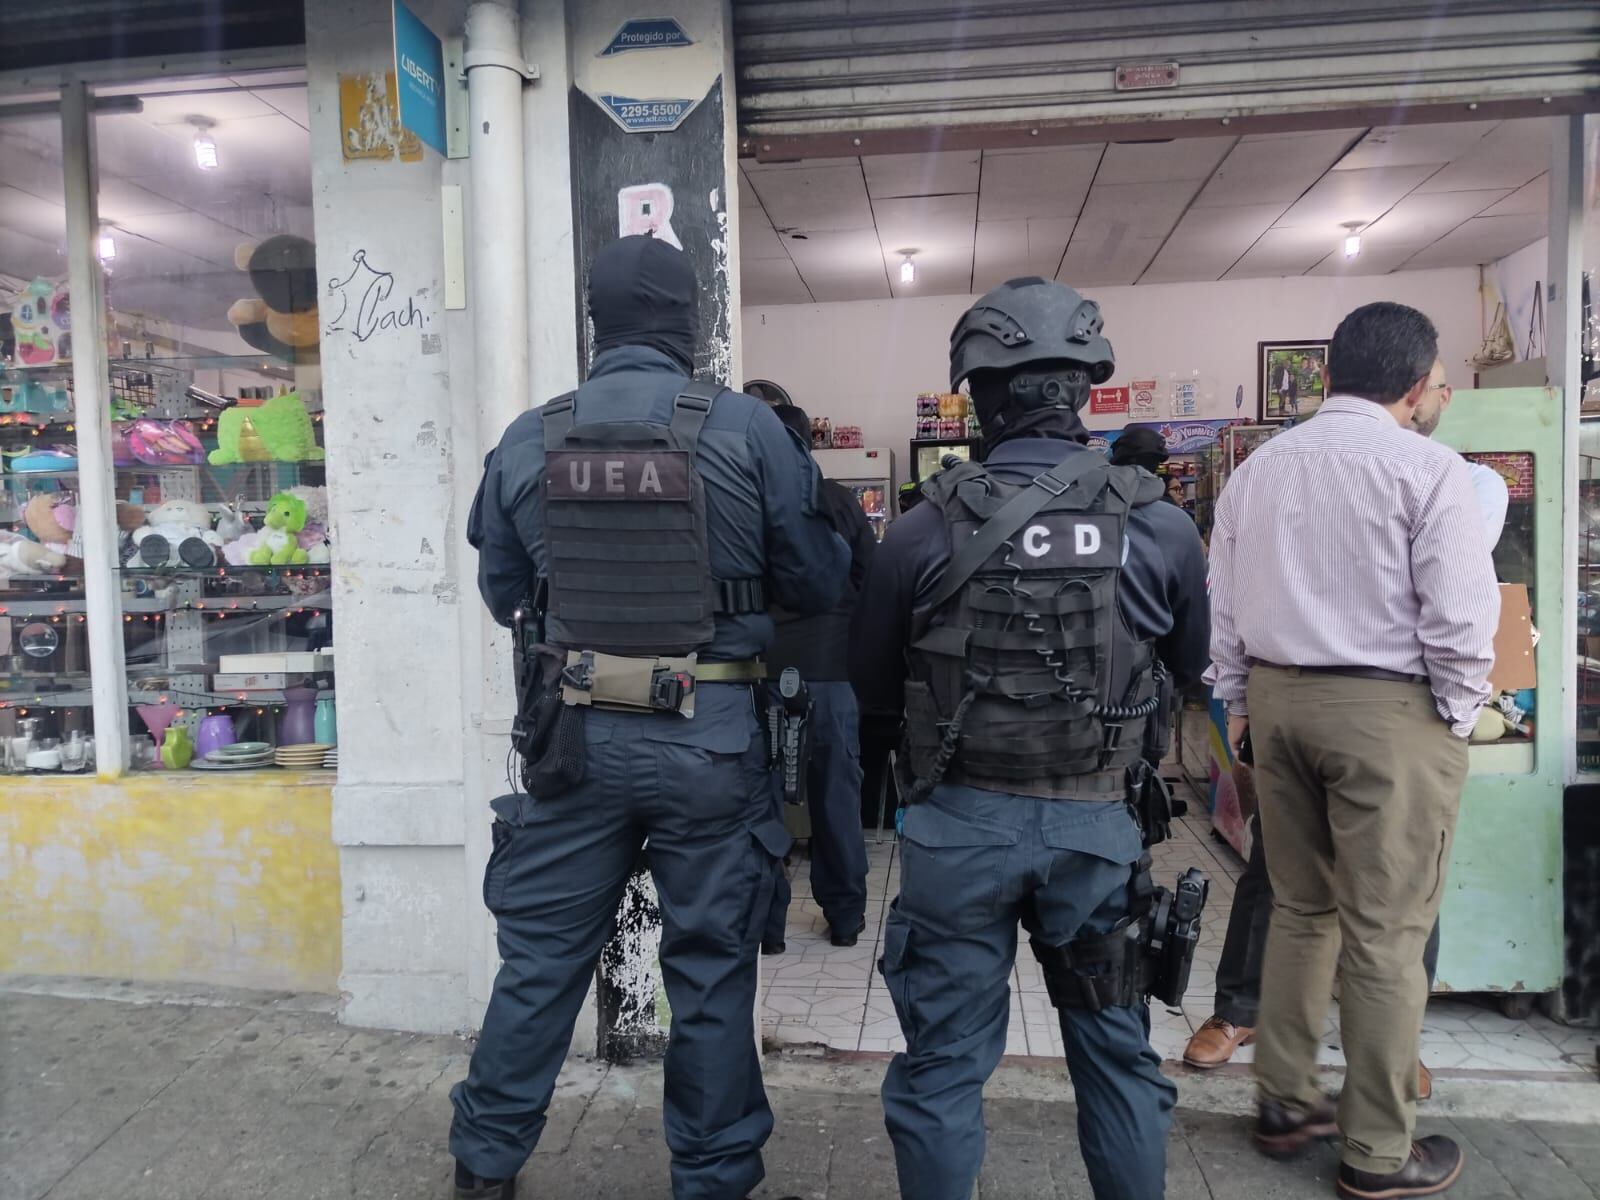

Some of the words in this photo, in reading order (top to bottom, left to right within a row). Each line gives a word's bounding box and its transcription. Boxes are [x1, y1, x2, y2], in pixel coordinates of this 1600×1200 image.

[620, 31, 663, 44] Protegido
[665, 31, 681, 42] por
[401, 53, 441, 96] LIBERTY
[620, 104, 681, 118] 2295-6500
[569, 460, 663, 494] UEA
